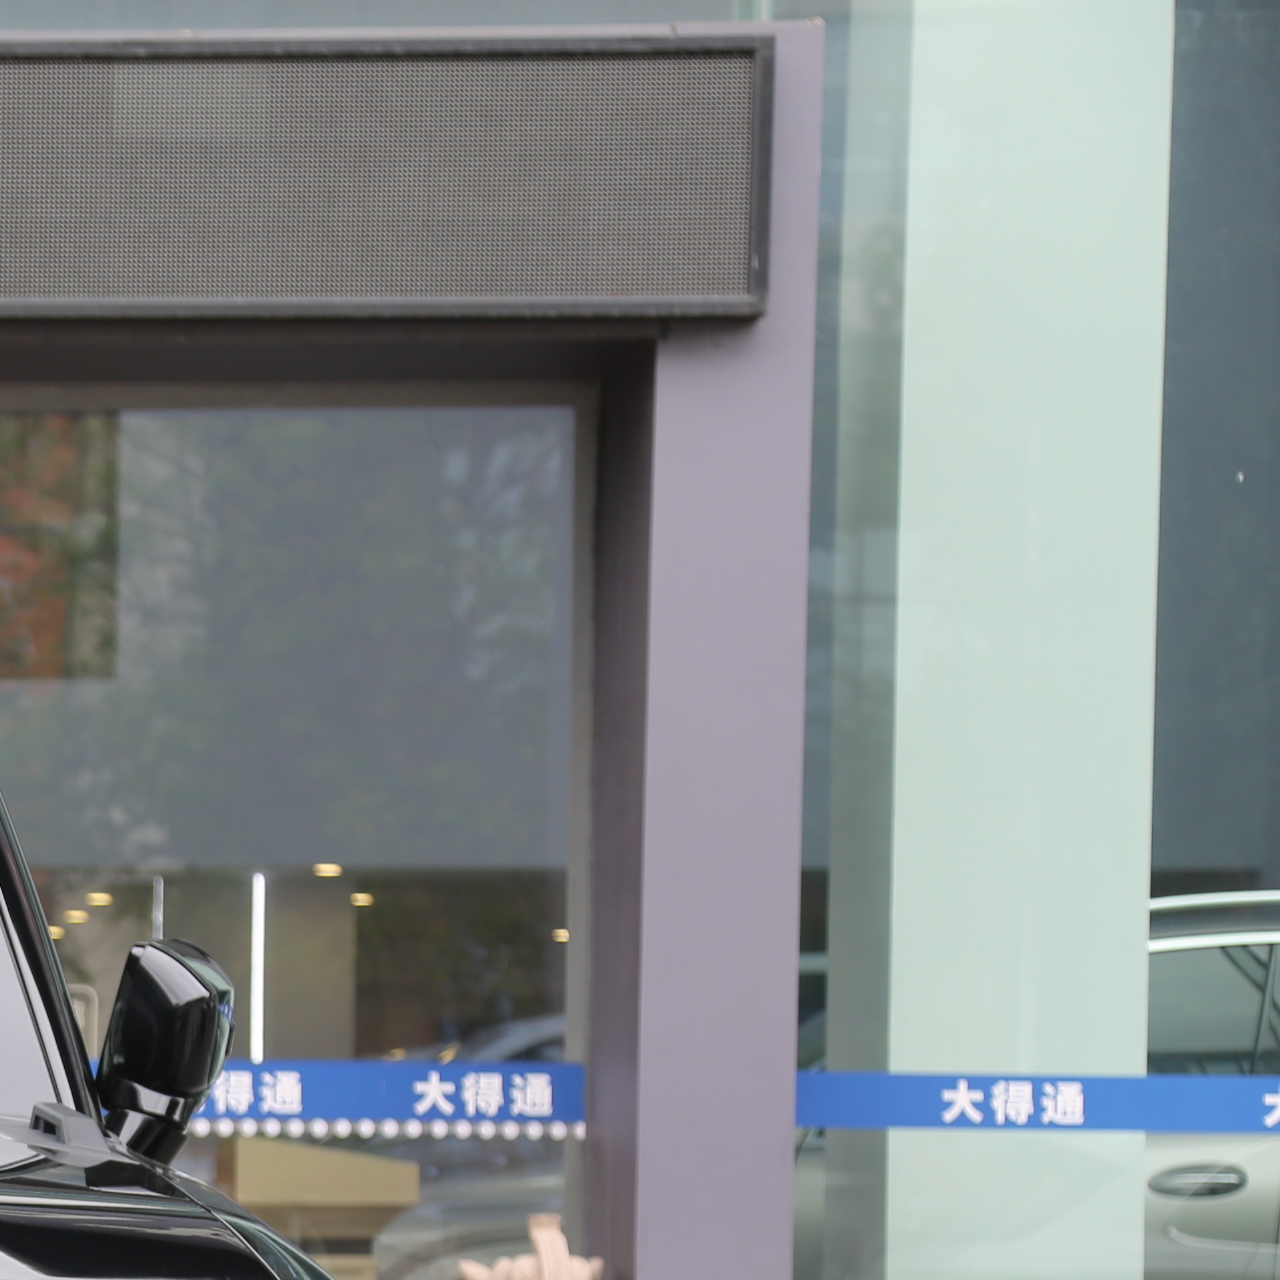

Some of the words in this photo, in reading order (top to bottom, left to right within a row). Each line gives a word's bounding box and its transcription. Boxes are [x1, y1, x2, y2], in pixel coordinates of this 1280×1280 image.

[197, 1069, 303, 1115] 得通
[413, 1070, 554, 1117] 大得通
[941, 1079, 1085, 1126] 大得通
